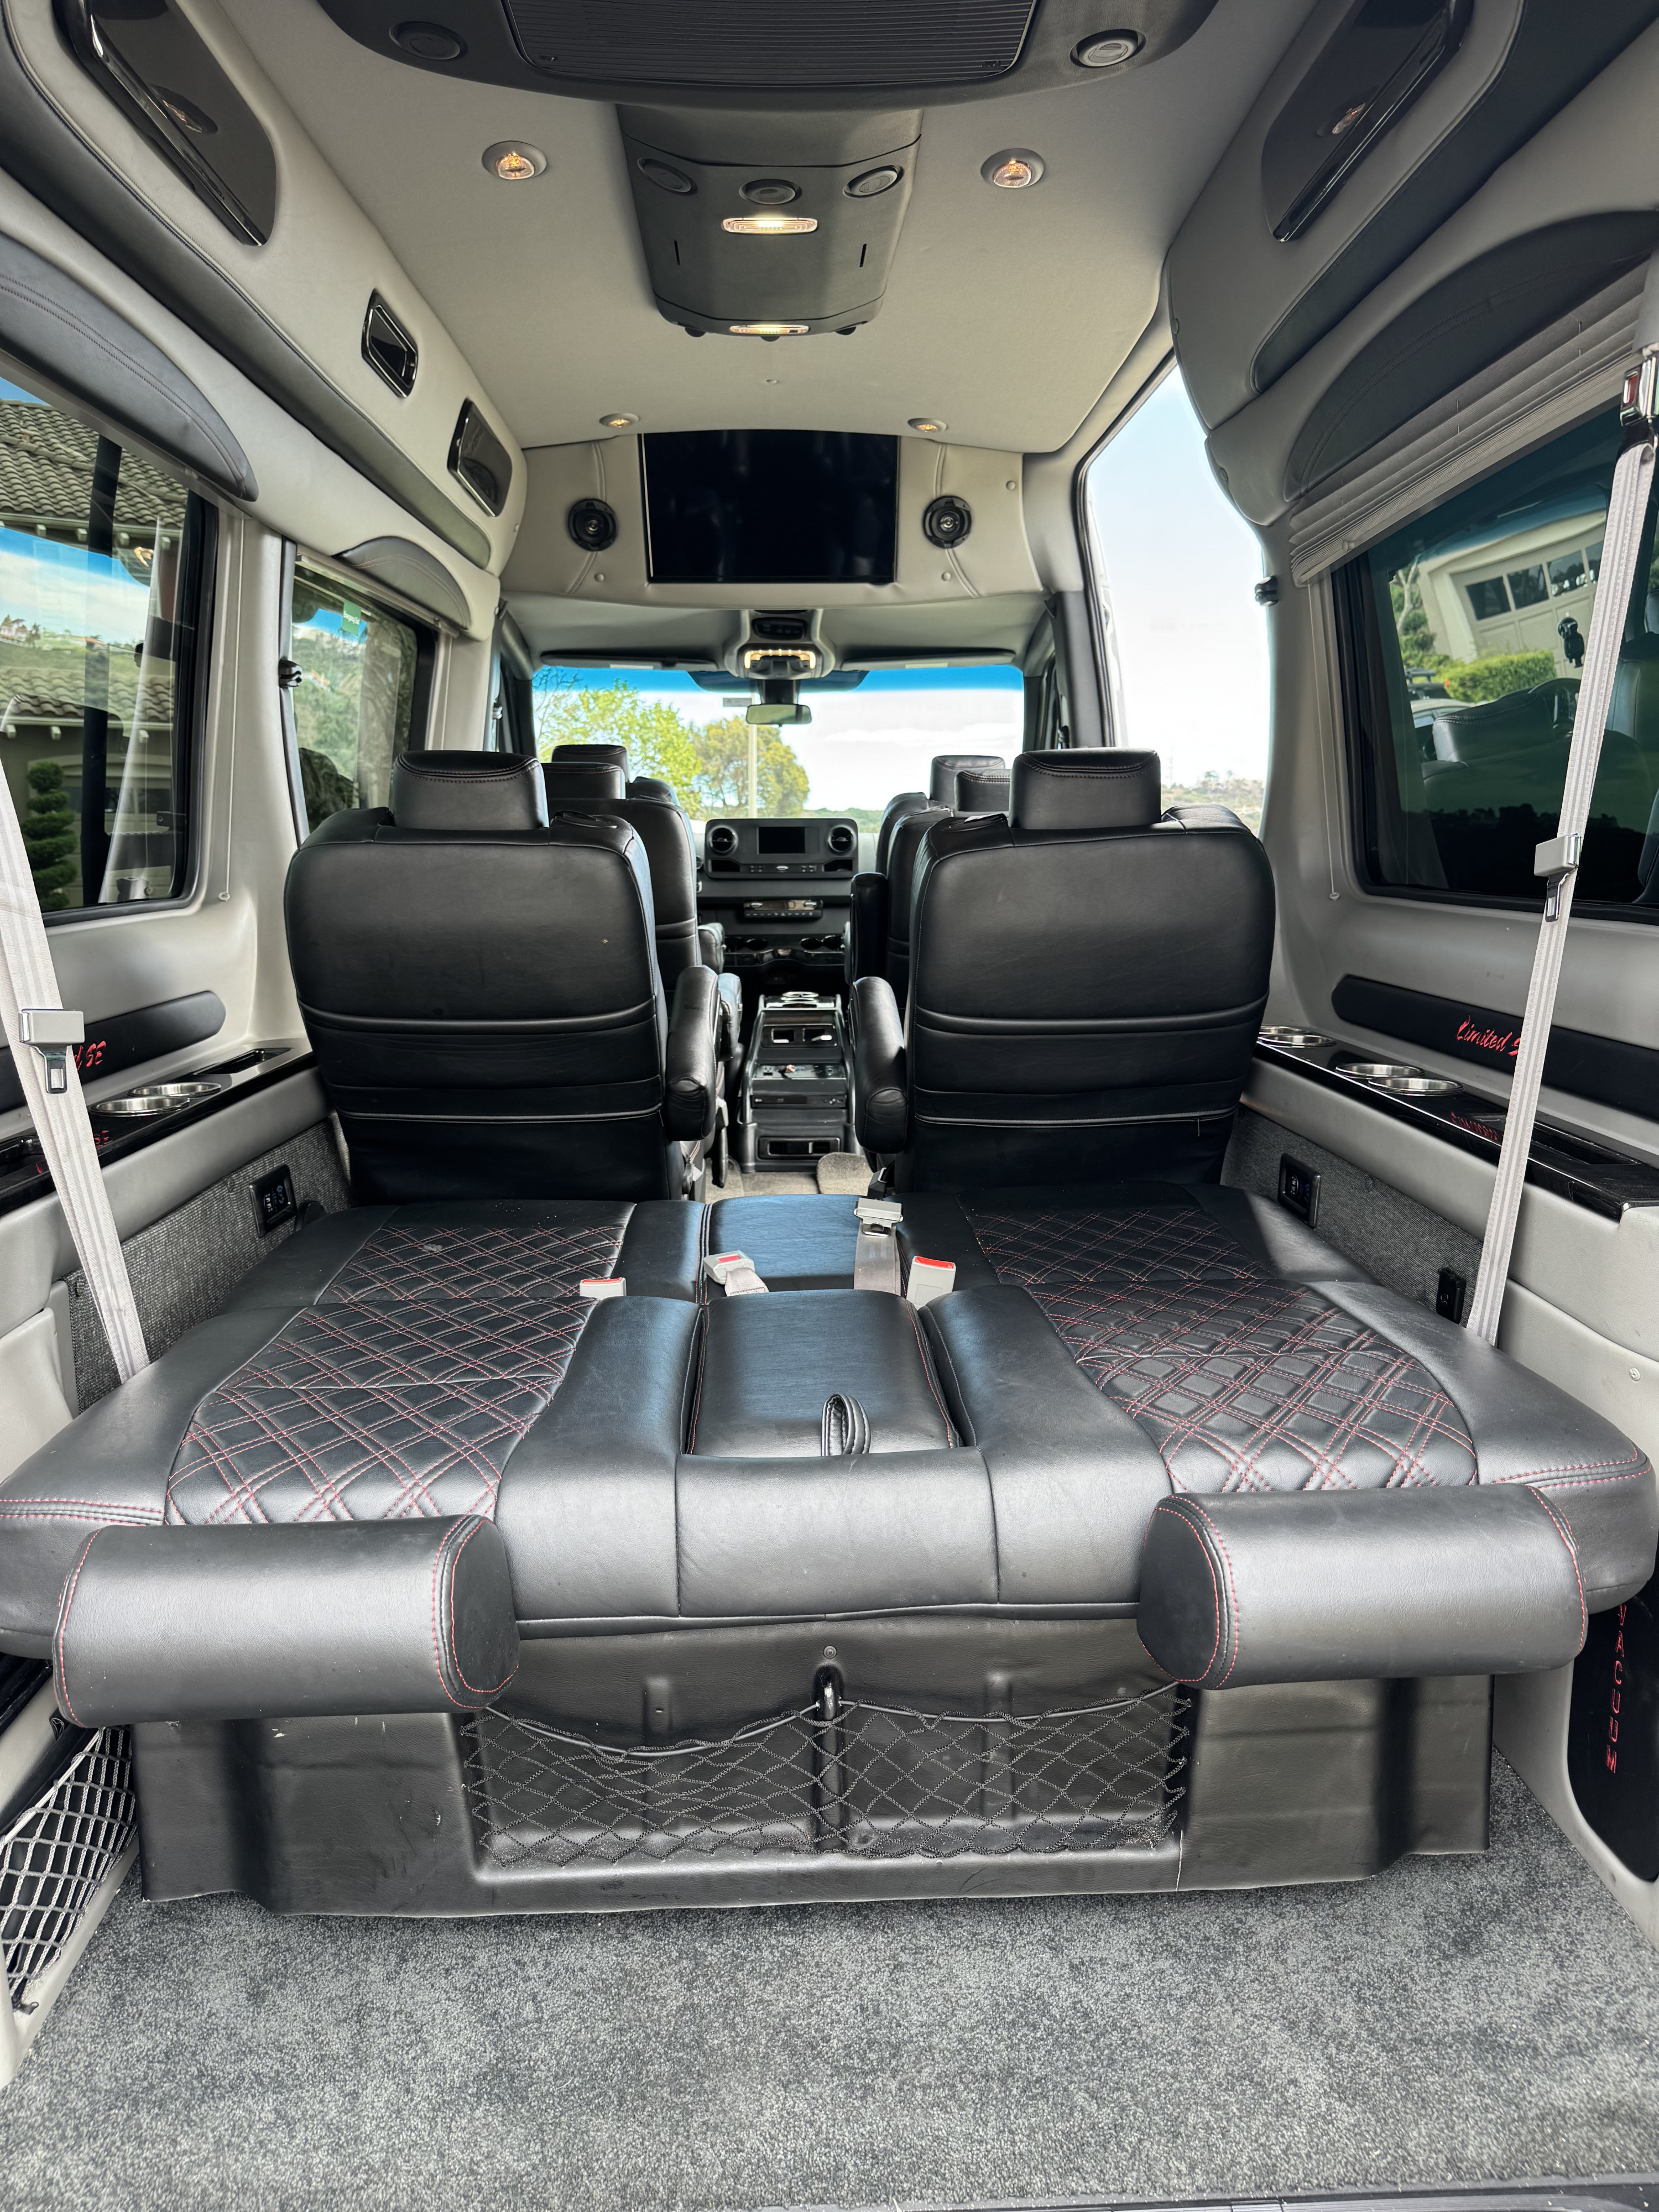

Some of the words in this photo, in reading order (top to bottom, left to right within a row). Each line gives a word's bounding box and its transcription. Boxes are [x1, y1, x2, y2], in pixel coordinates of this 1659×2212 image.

[86, 1040, 106, 1068] SE
[1457, 1015, 1512, 1052] Limited
[1507, 1037, 1521, 1056] S
[1606, 1604, 1626, 1773] VACUUM
